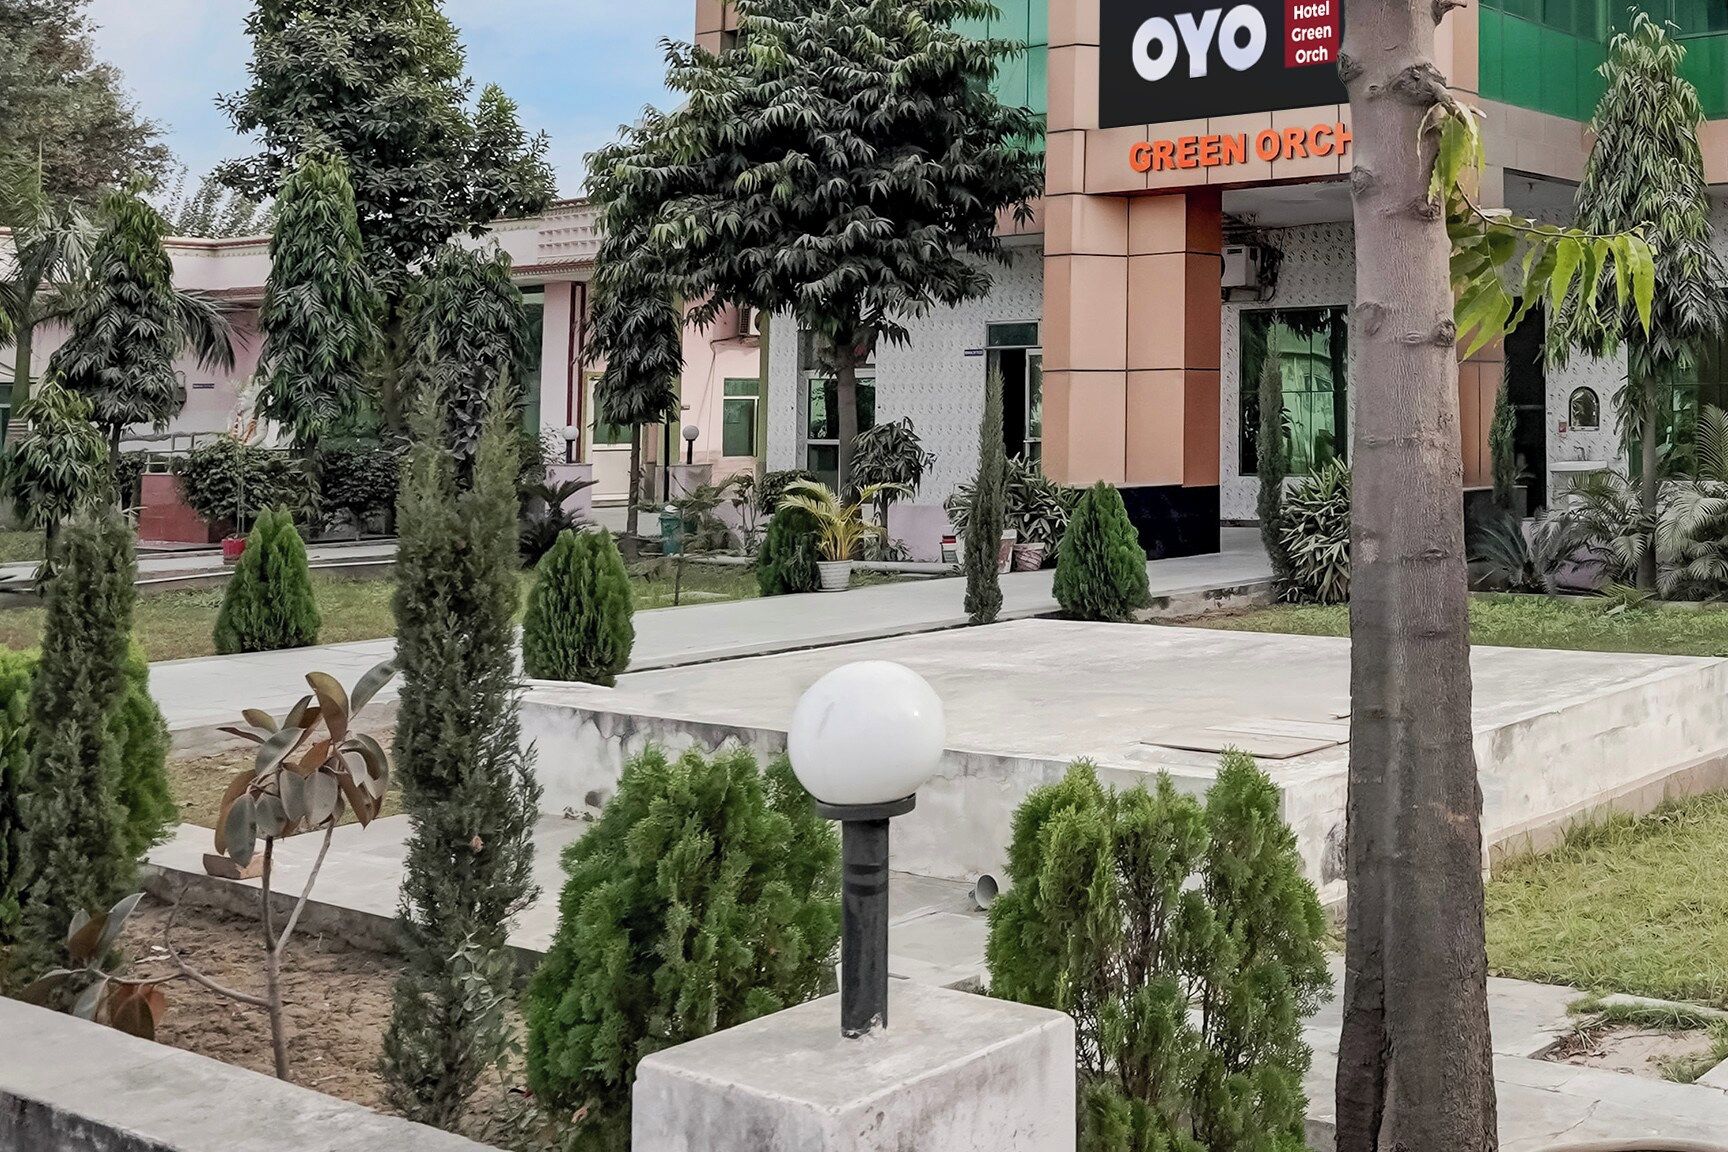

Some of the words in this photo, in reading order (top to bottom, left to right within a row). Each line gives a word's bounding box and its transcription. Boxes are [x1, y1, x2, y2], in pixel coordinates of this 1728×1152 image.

[1293, 0, 1330, 20] Hotel
[1131, 4, 1267, 81] OYO
[1291, 24, 1332, 42] Green
[1295, 46, 1328, 64] Orch
[1129, 132, 1247, 173] GREEN
